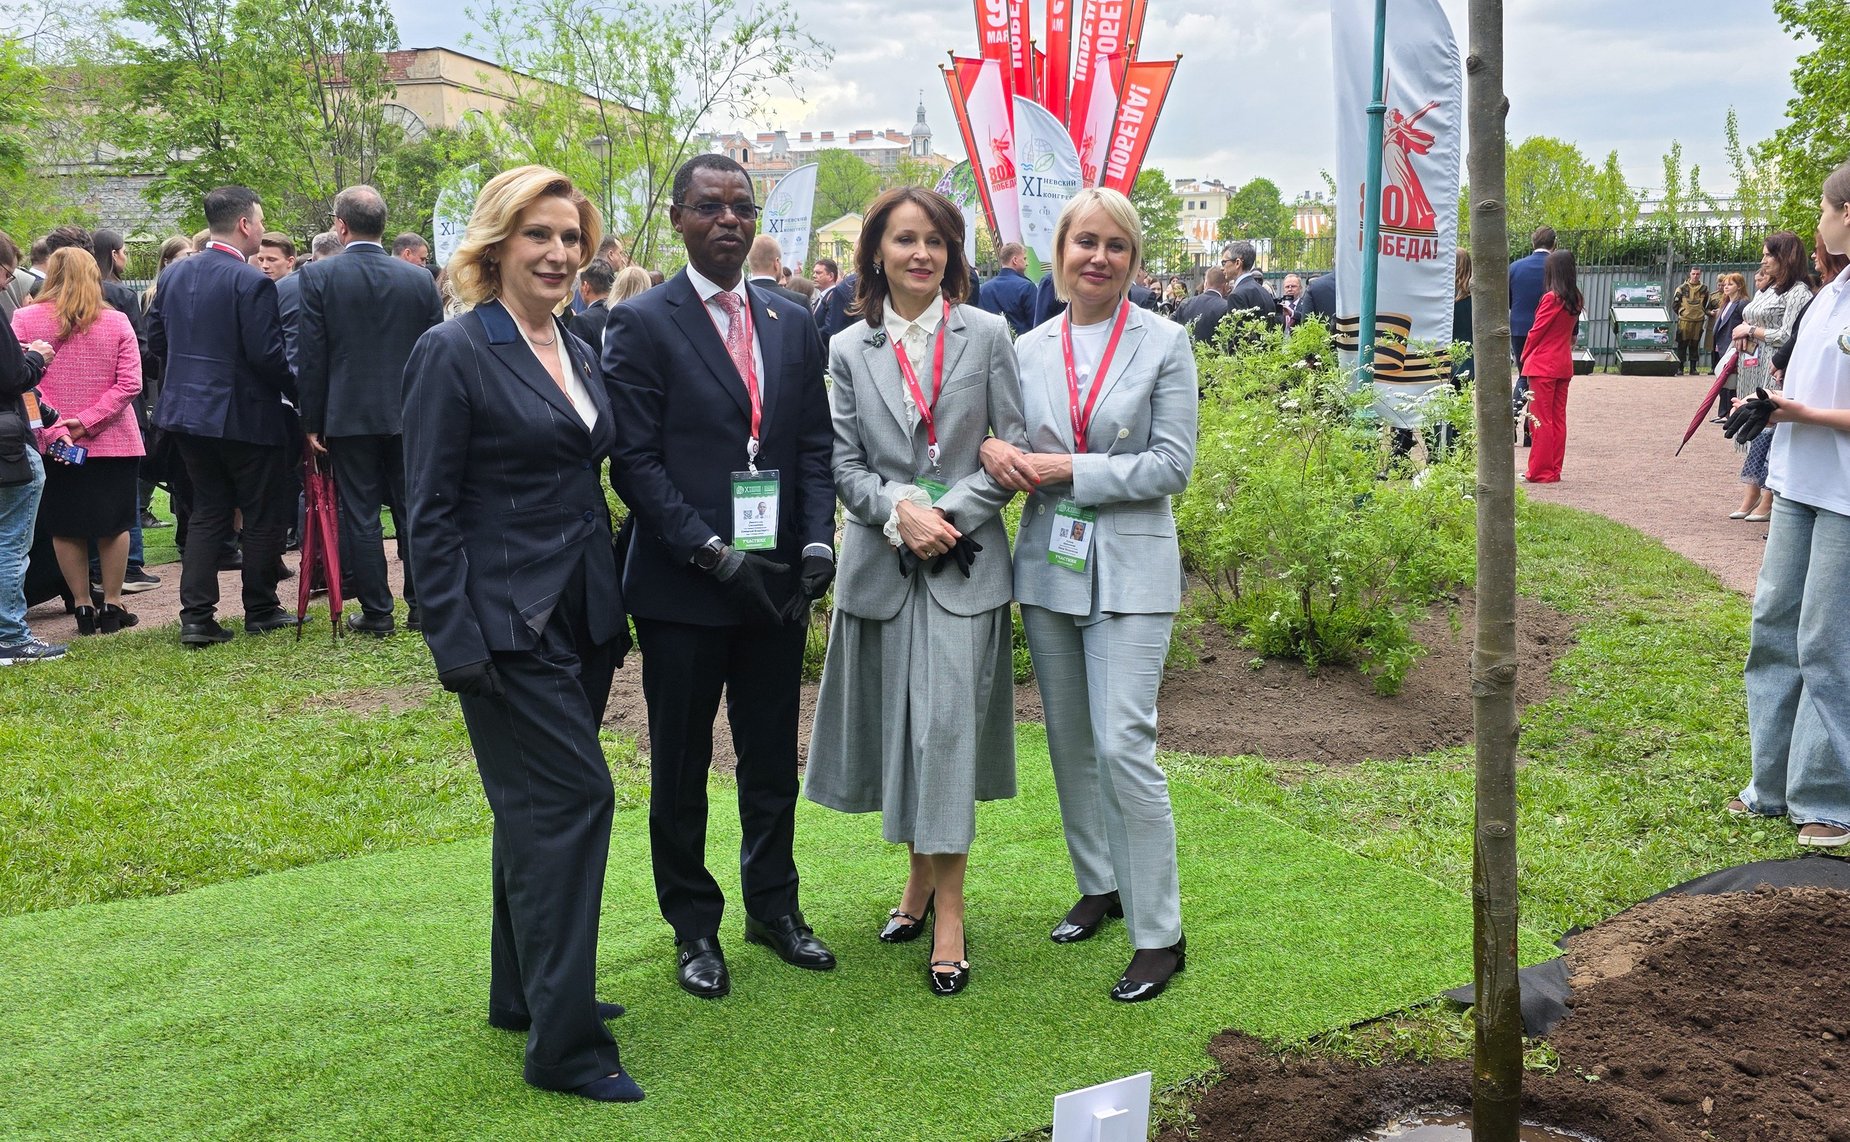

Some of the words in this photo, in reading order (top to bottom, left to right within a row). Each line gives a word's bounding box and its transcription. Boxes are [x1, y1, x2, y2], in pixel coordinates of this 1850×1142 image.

[985, 0, 1008, 27] 9
[989, 164, 1006, 183] 80
[1022, 175, 1042, 197] XI
[1043, 178, 1076, 187] НЕВСКИЙ
[1043, 192, 1074, 200] КОНГРЕС
[441, 221, 455, 235] XI
[769, 218, 784, 233] XI
